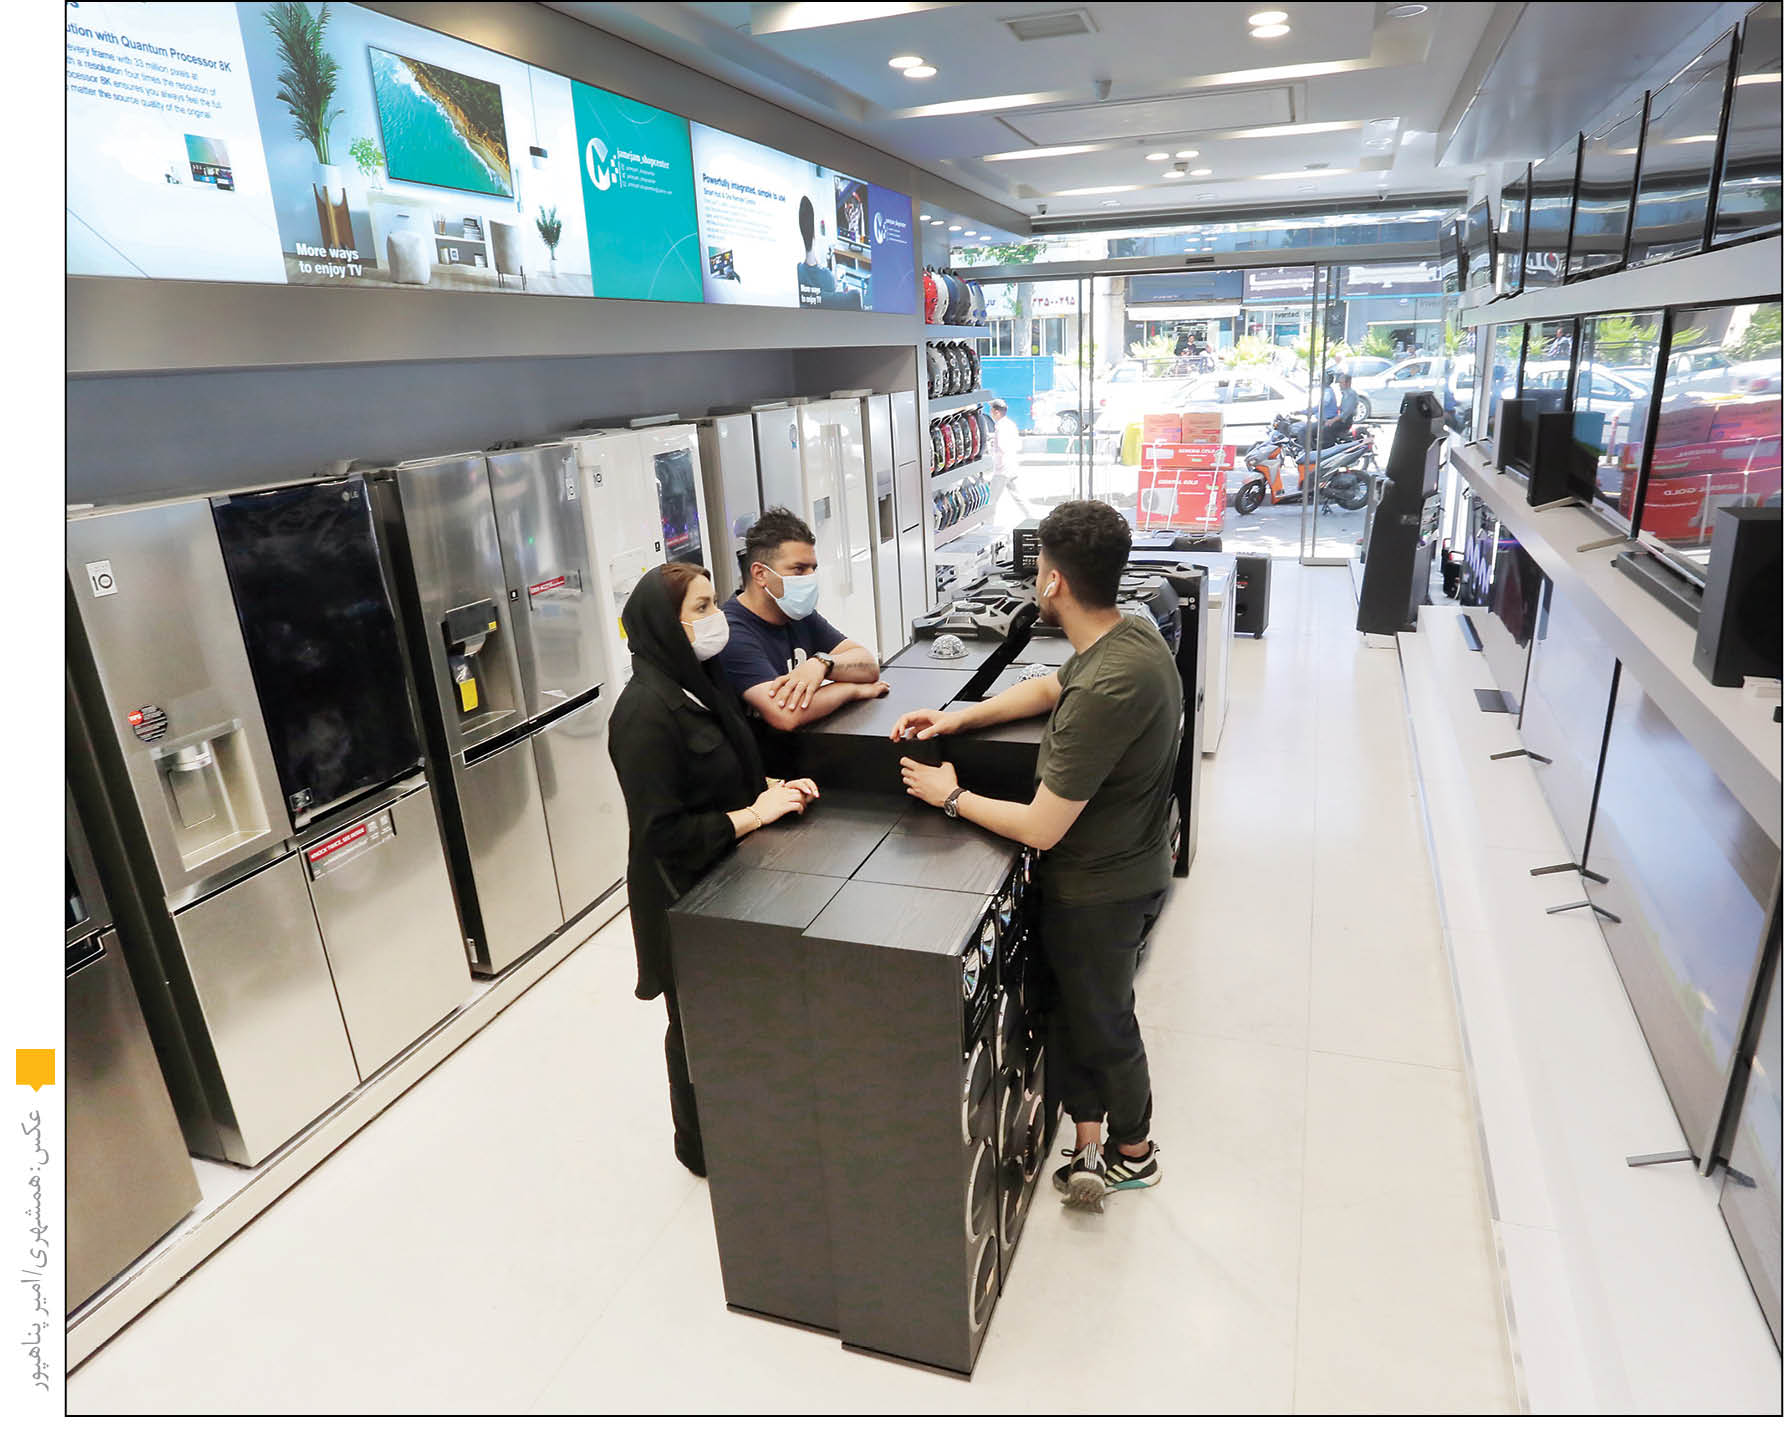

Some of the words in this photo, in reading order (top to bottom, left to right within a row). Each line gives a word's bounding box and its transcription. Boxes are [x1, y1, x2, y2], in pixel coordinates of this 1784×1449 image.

[95, 31, 119, 44] with
[121, 35, 168, 56] Quantum
[170, 48, 217, 69] Processor
[219, 59, 232, 72] 8K
[703, 172, 730, 190] Powerfully
[296, 242, 327, 258] More
[329, 247, 359, 262] ways
[299, 260, 312, 273] to
[314, 262, 346, 278] enjoy
[347, 263, 362, 276] TV
